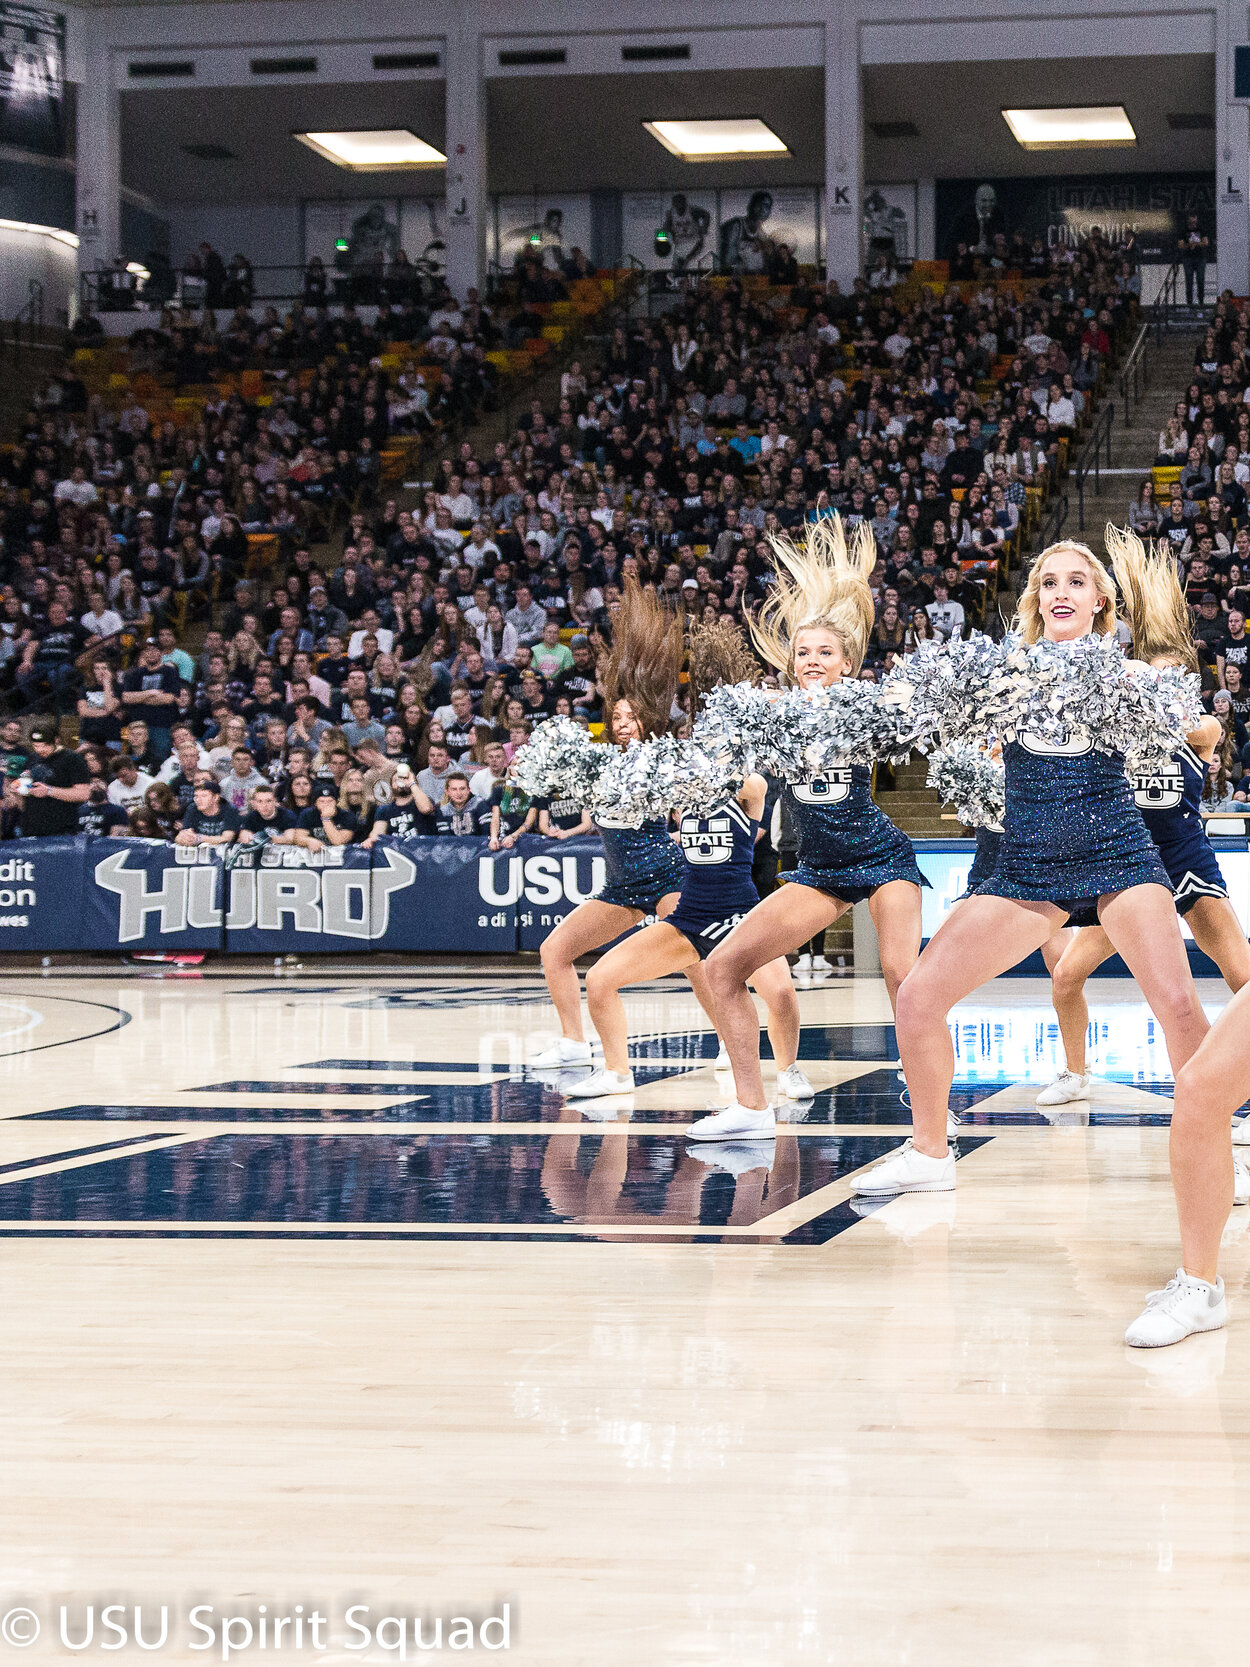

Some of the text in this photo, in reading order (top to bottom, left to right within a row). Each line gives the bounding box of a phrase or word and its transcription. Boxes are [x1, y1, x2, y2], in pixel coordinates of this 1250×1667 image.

[1227, 175, 1241, 194] L
[834, 186, 850, 204] K
[455, 197, 467, 215] J
[83, 210, 97, 226] H
[1129, 775, 1185, 791] STATE
[680, 831, 734, 849] STATE
[478, 855, 607, 906] USU
